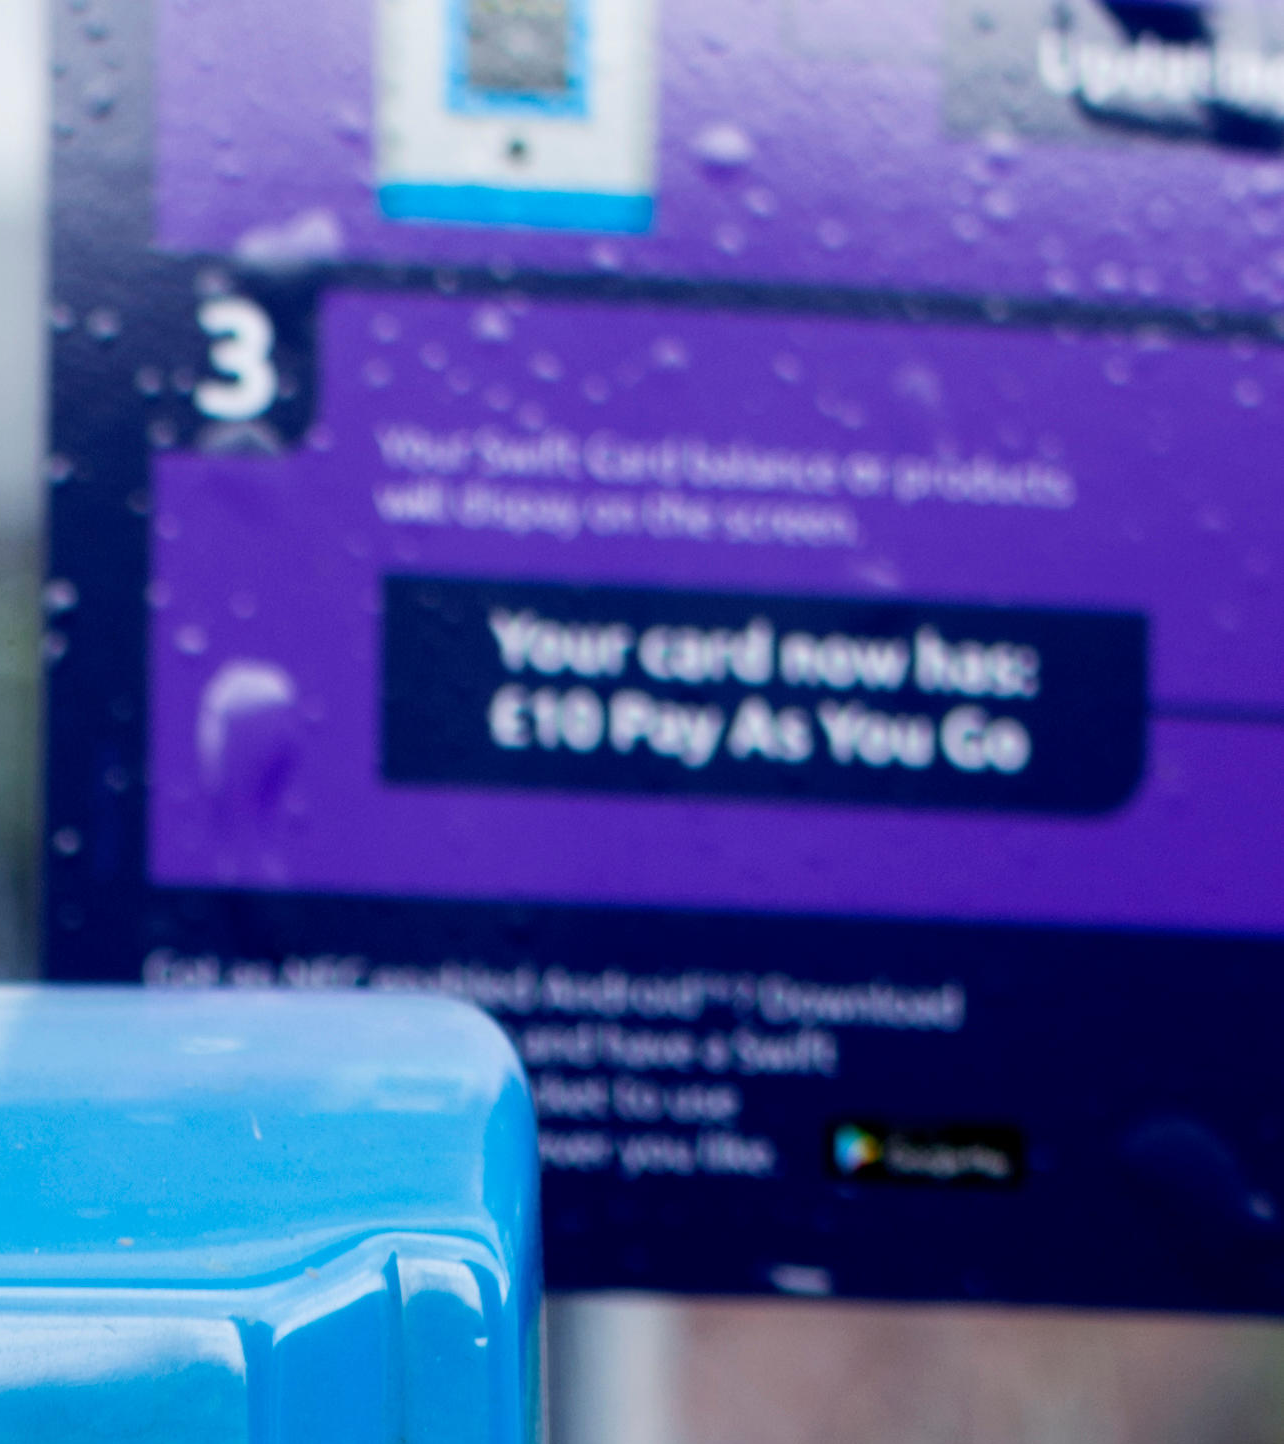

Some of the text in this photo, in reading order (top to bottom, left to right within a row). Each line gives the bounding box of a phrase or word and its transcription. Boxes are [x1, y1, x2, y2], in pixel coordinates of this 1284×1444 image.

[194, 298, 279, 422] 3
[375, 425, 473, 475] Your
[475, 426, 582, 480] Swift
[489, 605, 1039, 698] Your card now has:
[489, 684, 1032, 775] £10 Pay As You Go
